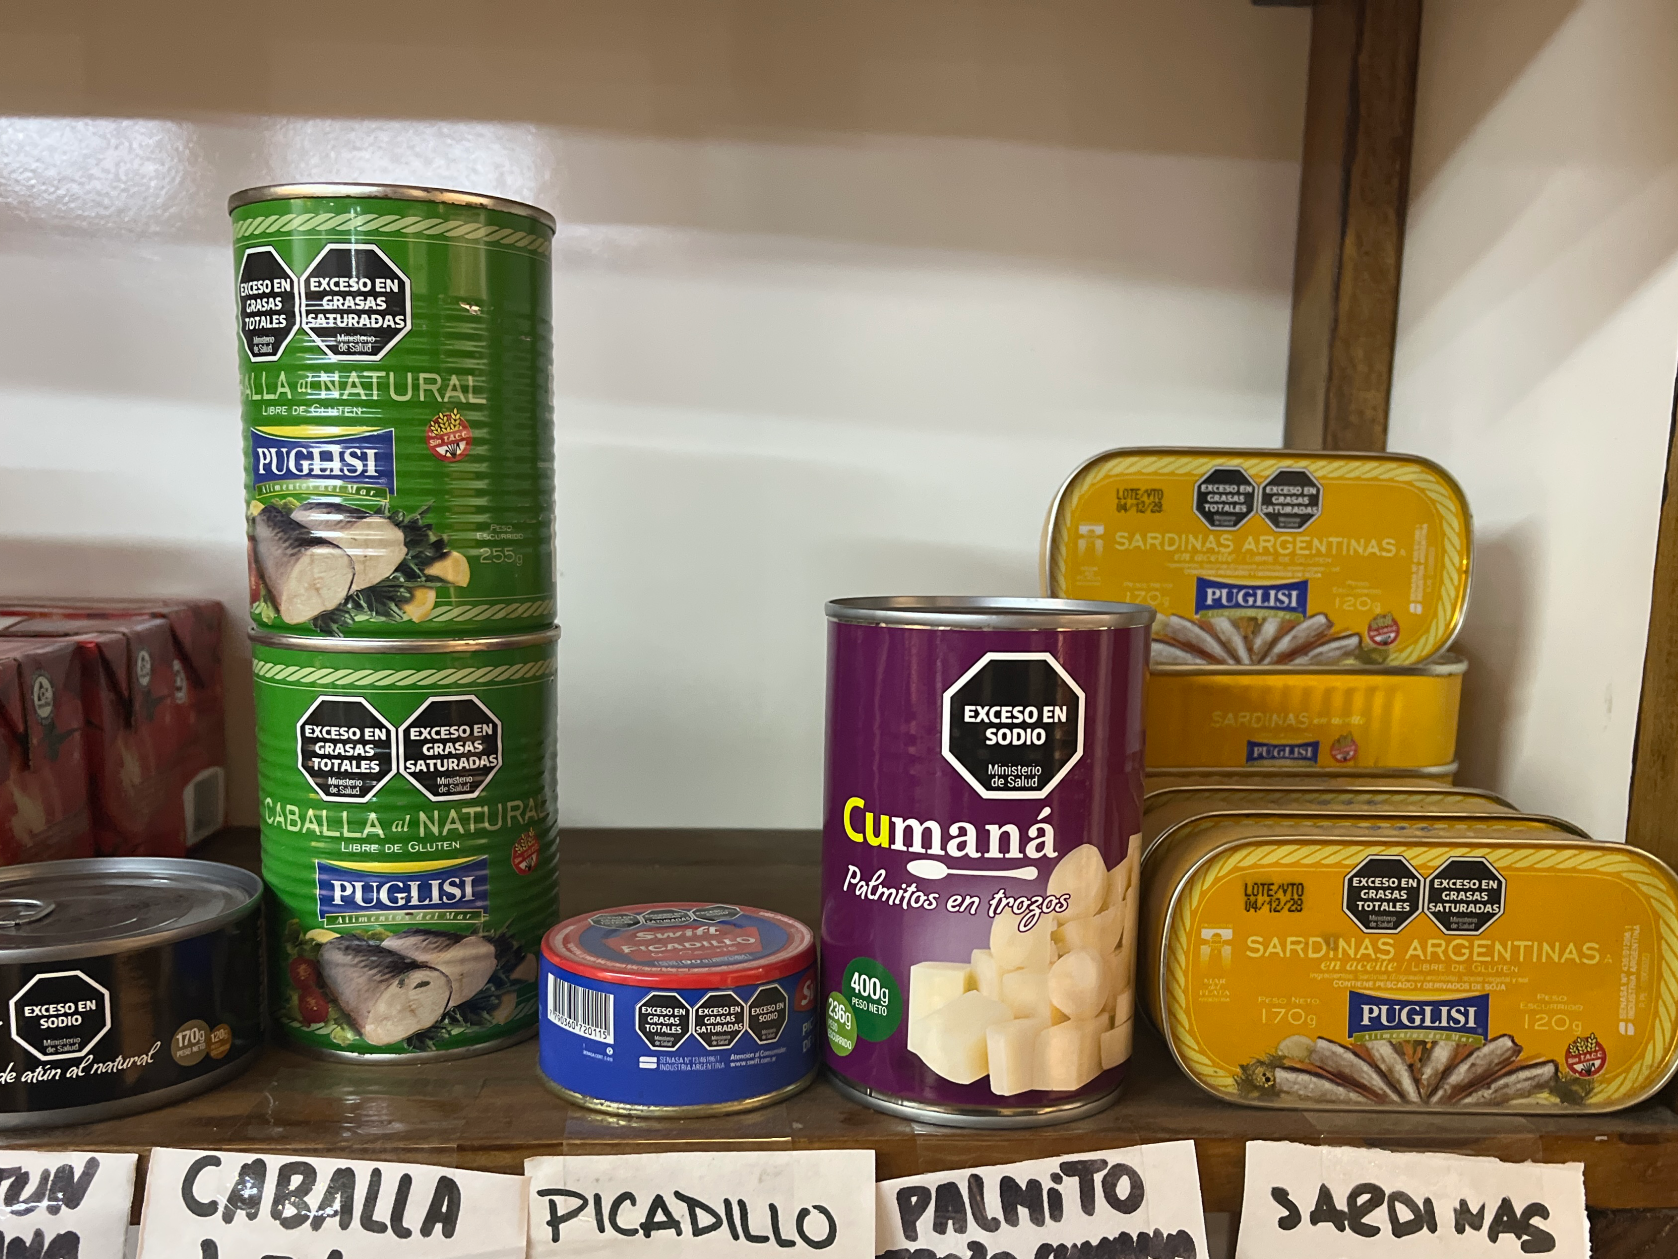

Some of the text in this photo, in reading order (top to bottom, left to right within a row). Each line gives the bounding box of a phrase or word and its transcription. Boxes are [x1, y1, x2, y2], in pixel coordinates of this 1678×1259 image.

[240, 278, 291, 297] EXCESO EN
[310, 277, 399, 292] EXCESO EN
[246, 297, 283, 313] GRASAS
[323, 296, 387, 311] GRASAS
[245, 314, 287, 331] TOTALES
[307, 313, 406, 329] SATURADAS
[336, 333, 375, 343] Ministerio
[338, 343, 372, 352] de Salud
[320, 370, 487, 404] NATURAL
[429, 437, 442, 448] Sin
[257, 447, 380, 476] PUGLISI
[347, 485, 376, 497] Mar
[1201, 484, 1253, 493] EXCESO EN
[1265, 486, 1317, 495] EXCESO EN
[1207, 494, 1245, 503] GRASAS
[1272, 496, 1309, 505] GRASAS
[1204, 503, 1247, 513] TOTALES
[1260, 504, 1318, 514] SATURADAS
[1114, 531, 1397, 557] SARDINAS ARGENTINAS
[479, 547, 523, 567] 255g
[1204, 587, 1299, 608] PUGLISI
[963, 705, 1067, 724] EXCESO EN
[304, 725, 387, 740] EXCESO EN
[410, 723, 493, 740] EXCESO EN
[985, 727, 1047, 746] SODIO
[315, 741, 375, 756] GRASAS
[422, 740, 483, 756] GRASAS
[1253, 745, 1313, 759] PUGLISI
[312, 757, 380, 773] TOTALES
[405, 754, 498, 773] SATURADAS
[987, 763, 1042, 776] Ministerio
[328, 776, 363, 787] Ministerio
[437, 775, 473, 785] Ministerio
[991, 775, 1038, 788] de Salud
[329, 785, 360, 795] de Salud
[438, 783, 470, 793] de Salud
[265, 797, 385, 839] CABALLA
[391, 815, 411, 833] al
[843, 796, 1059, 859] Cumaná
[1352, 877, 1418, 888] EXCESO EN
[1434, 879, 1498, 890] EXCESO EN
[331, 876, 475, 907] PUGLISI
[843, 865, 1071, 932] Palmitos en trozos
[1360, 889, 1407, 899] GRASAS
[1442, 891, 1488, 901] GRASAS
[1356, 901, 1410, 912] TOTALES
[1428, 903, 1500, 914] SATURADAS
[336, 911, 472, 924] Alimentos del Mar
[635, 926, 720, 940] Swift
[621, 936, 756, 953] PICADILLO
[1246, 935, 1395, 960] SARDINAS
[1405, 939, 1600, 965] ARGENTINAS
[1320, 960, 1340, 971] en
[1346, 958, 1398, 971] aceite
[851, 971, 889, 1006] 400g
[1333, 979, 1373, 988] CONTIENE
[1375, 981, 1415, 989] PESCADO
[24, 999, 97, 1017] EXCESO EN
[642, 1006, 686, 1016] EXCESO EN
[698, 1006, 741, 1016] EXCESO EN
[751, 1002, 784, 1016] EXCESO EN
[852, 996, 887, 1016] PESO NETO
[647, 1015, 680, 1024] GRASAS
[704, 1015, 735, 1024] GRASAS
[758, 1012, 778, 1022] SODIO
[828, 997, 851, 1030] 236g
[1262, 1008, 1317, 1028] 170g
[1360, 1004, 1477, 1027] PUGLISI
[40, 1014, 82, 1029] SODIO
[696, 1022, 743, 1034] SATURADAS
[1524, 1014, 1582, 1035] 120g
[578, 1022, 608, 1039] 720115
[645, 1024, 682, 1034] TOTALES
[43, 1036, 81, 1047] Ministerio
[176, 1027, 205, 1048] 170g
[46, 1043, 79, 1053] de Salud
[21, 1064, 61, 1084] atún
[66, 1054, 94, 1079] al
[90, 1040, 161, 1075] natural
[659, 1055, 684, 1064] SENASA
[659, 1062, 725, 1071] INDUSTRIA ARGENTINA
[1567, 1056, 1578, 1065] Sin
[181, 1155, 462, 1239] CABALLA
[536, 1188, 837, 1249] PICADILLO
